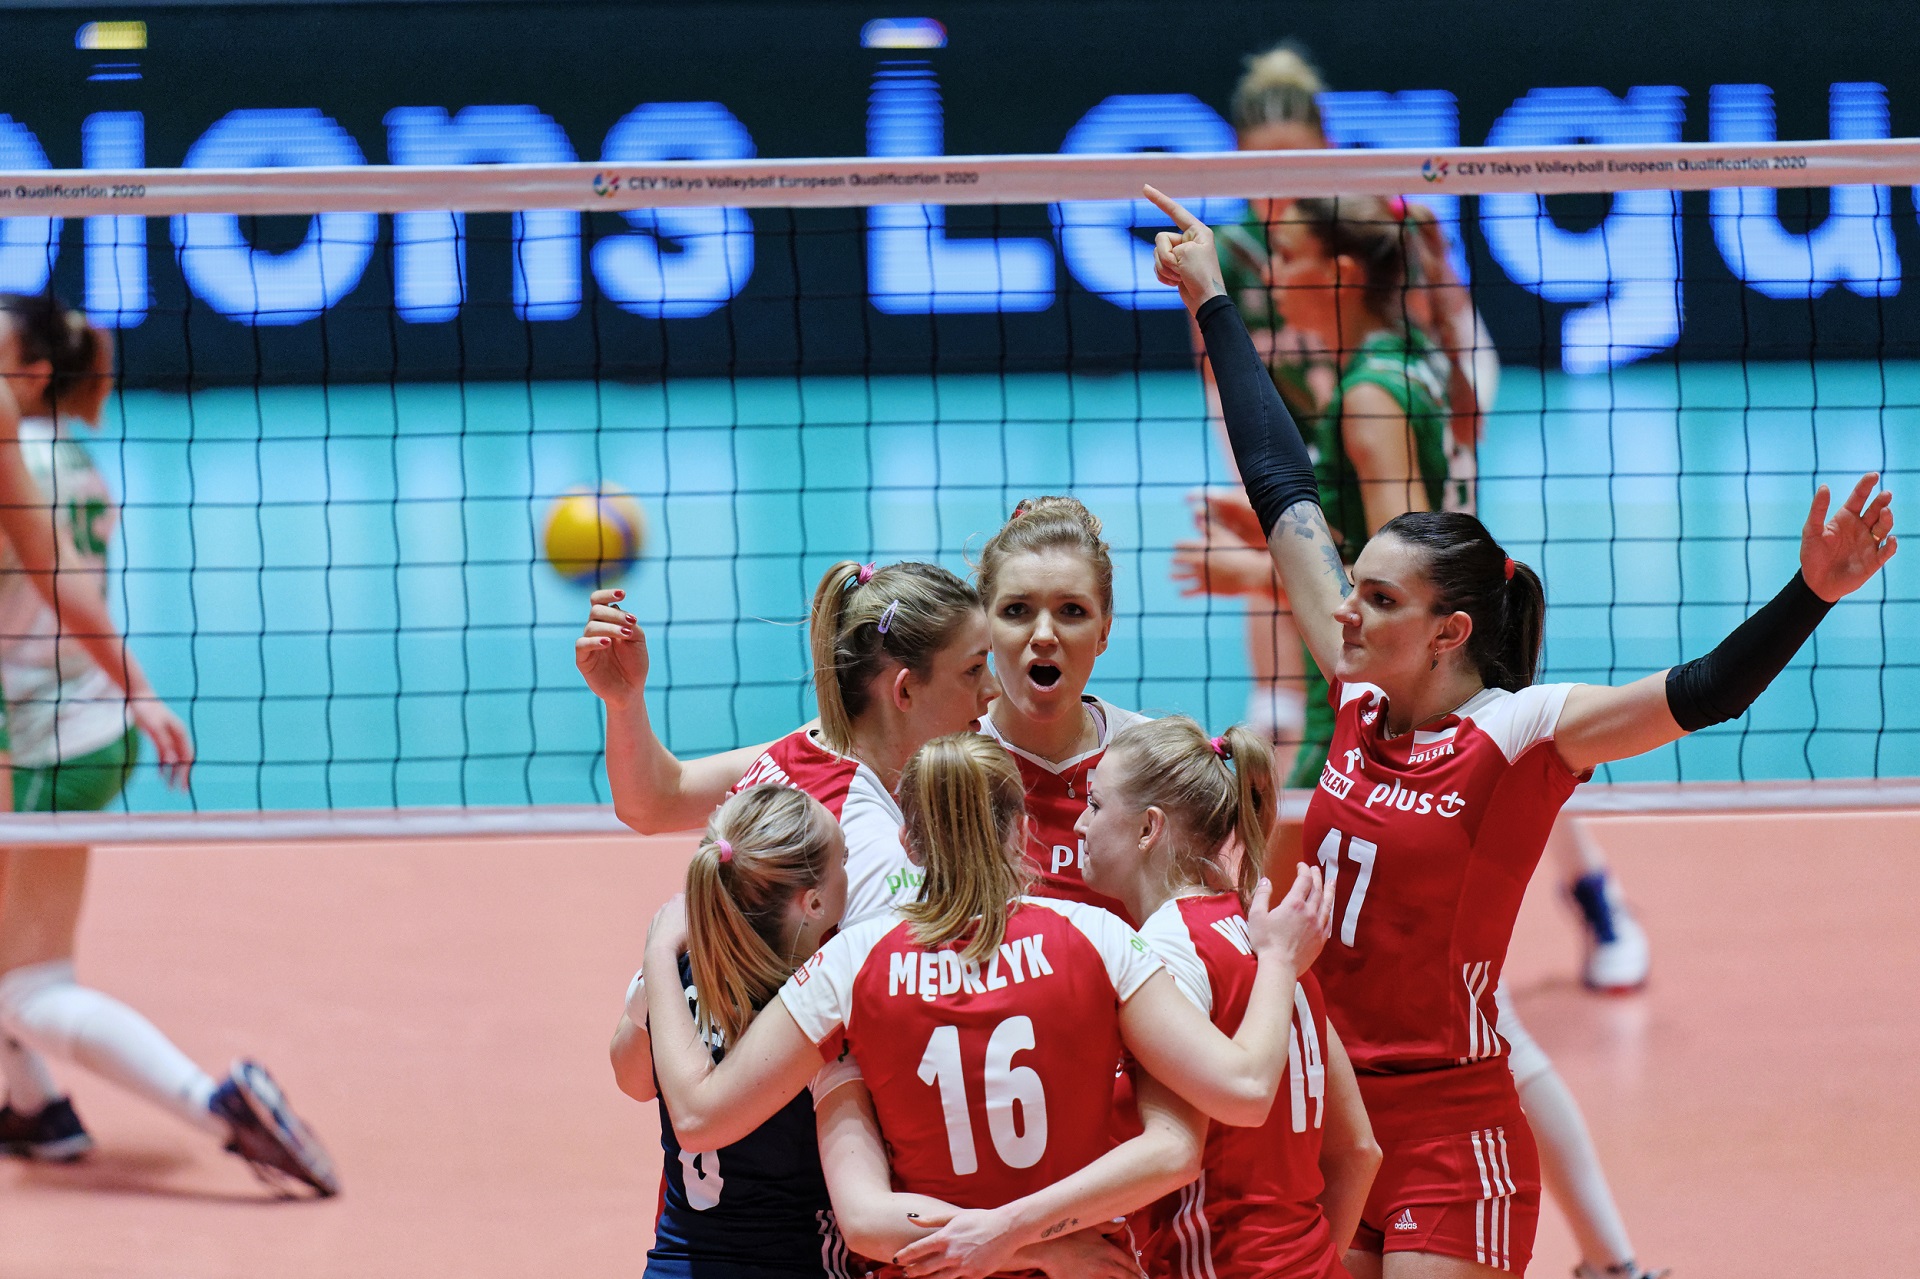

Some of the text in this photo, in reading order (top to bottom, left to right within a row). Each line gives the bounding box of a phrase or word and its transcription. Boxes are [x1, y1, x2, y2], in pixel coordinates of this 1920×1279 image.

[1457, 155, 1808, 176] CEV Tokyo Volleyball European Qualification 2020
[15, 184, 108, 198] Qualification
[112, 184, 146, 198] 2020
[661, 176, 703, 191] Tokyo
[707, 174, 776, 191] Volleyball
[779, 175, 846, 188] European
[849, 172, 941, 186] Qualification
[944, 171, 979, 185] 2020
[1407, 743, 1455, 765] POLSKA
[886, 867, 926, 895] plu
[1316, 827, 1378, 948] 17
[888, 933, 1054, 1003] MĘDRZYK
[1288, 981, 1325, 1134] 14
[916, 1014, 1049, 1177] 16
[1394, 1221, 1418, 1230] adidas
